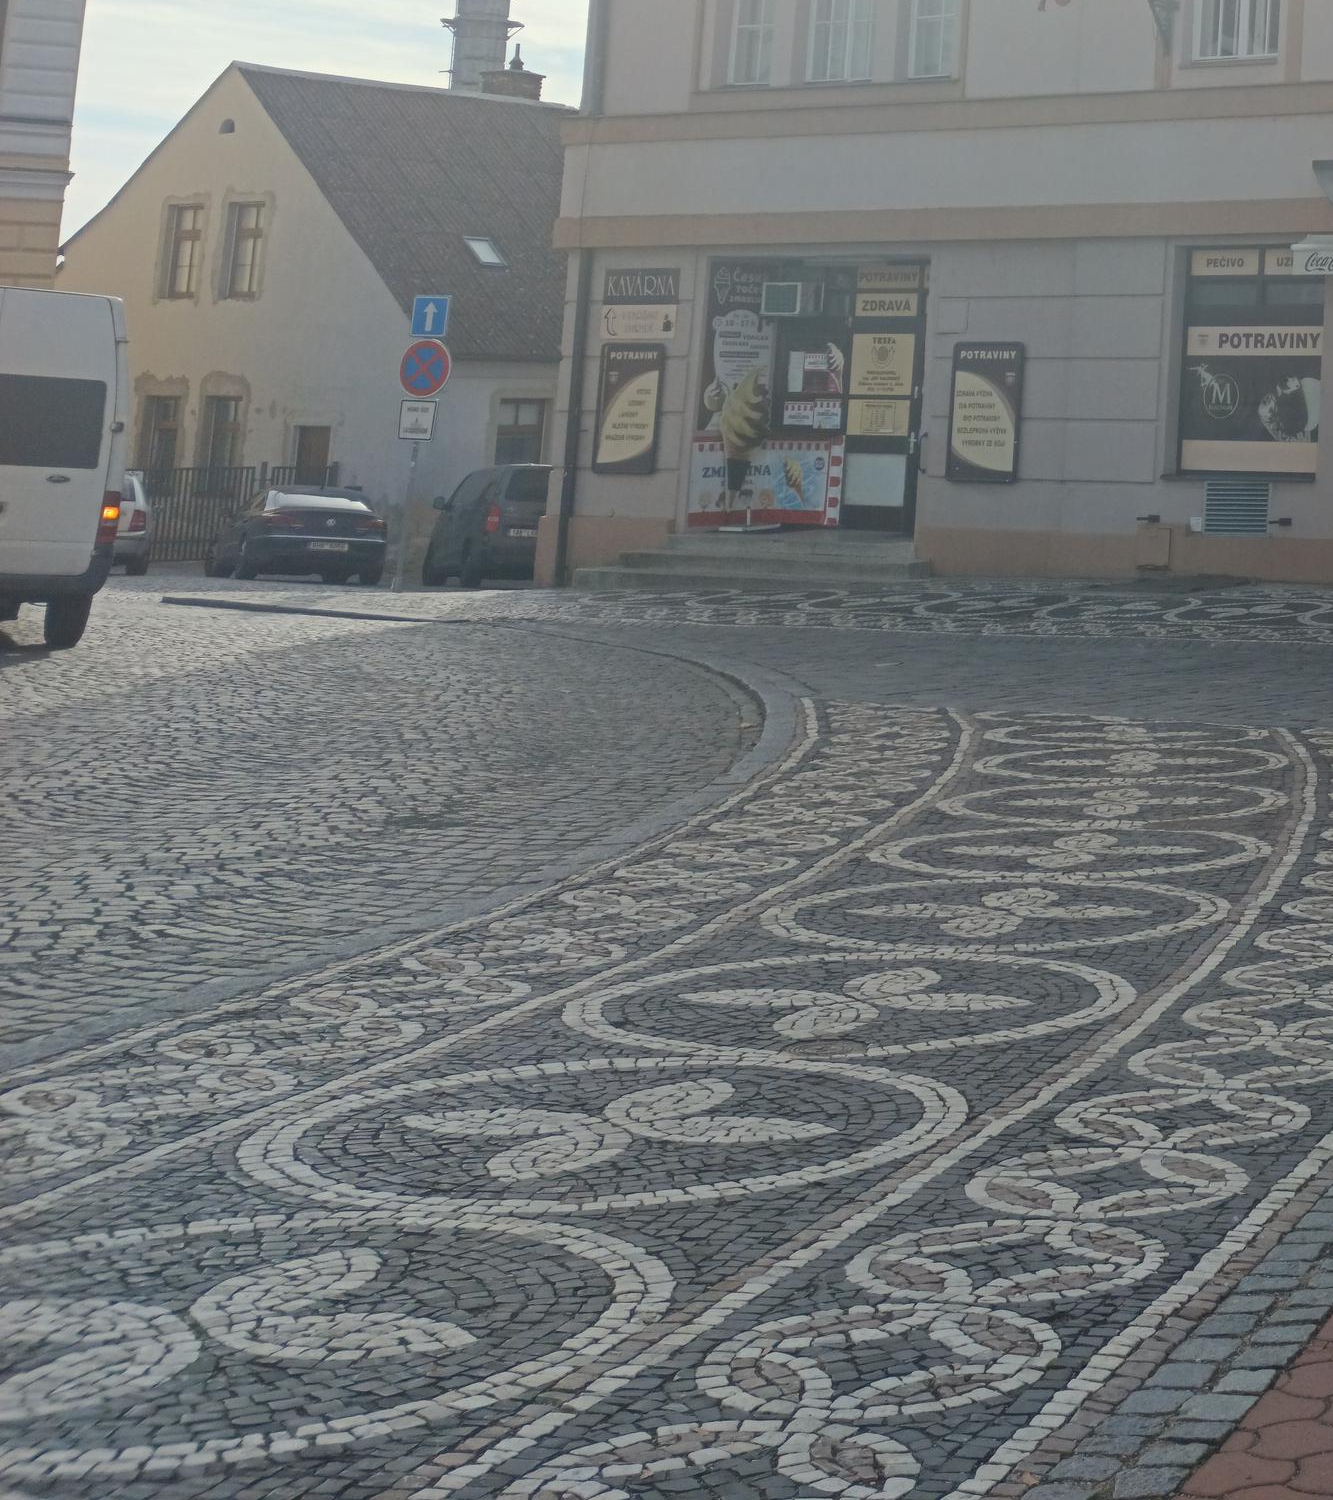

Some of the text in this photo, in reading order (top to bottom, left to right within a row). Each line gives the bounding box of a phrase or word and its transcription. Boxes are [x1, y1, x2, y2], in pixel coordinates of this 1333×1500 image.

[1206, 255, 1245, 268] PEČIVO
[607, 271, 676, 297] KAVÁRNA
[1218, 331, 1321, 349] POTRAVINY
[609, 350, 658, 360] POTRAVINY
[960, 350, 1017, 360] POTRAVINY
